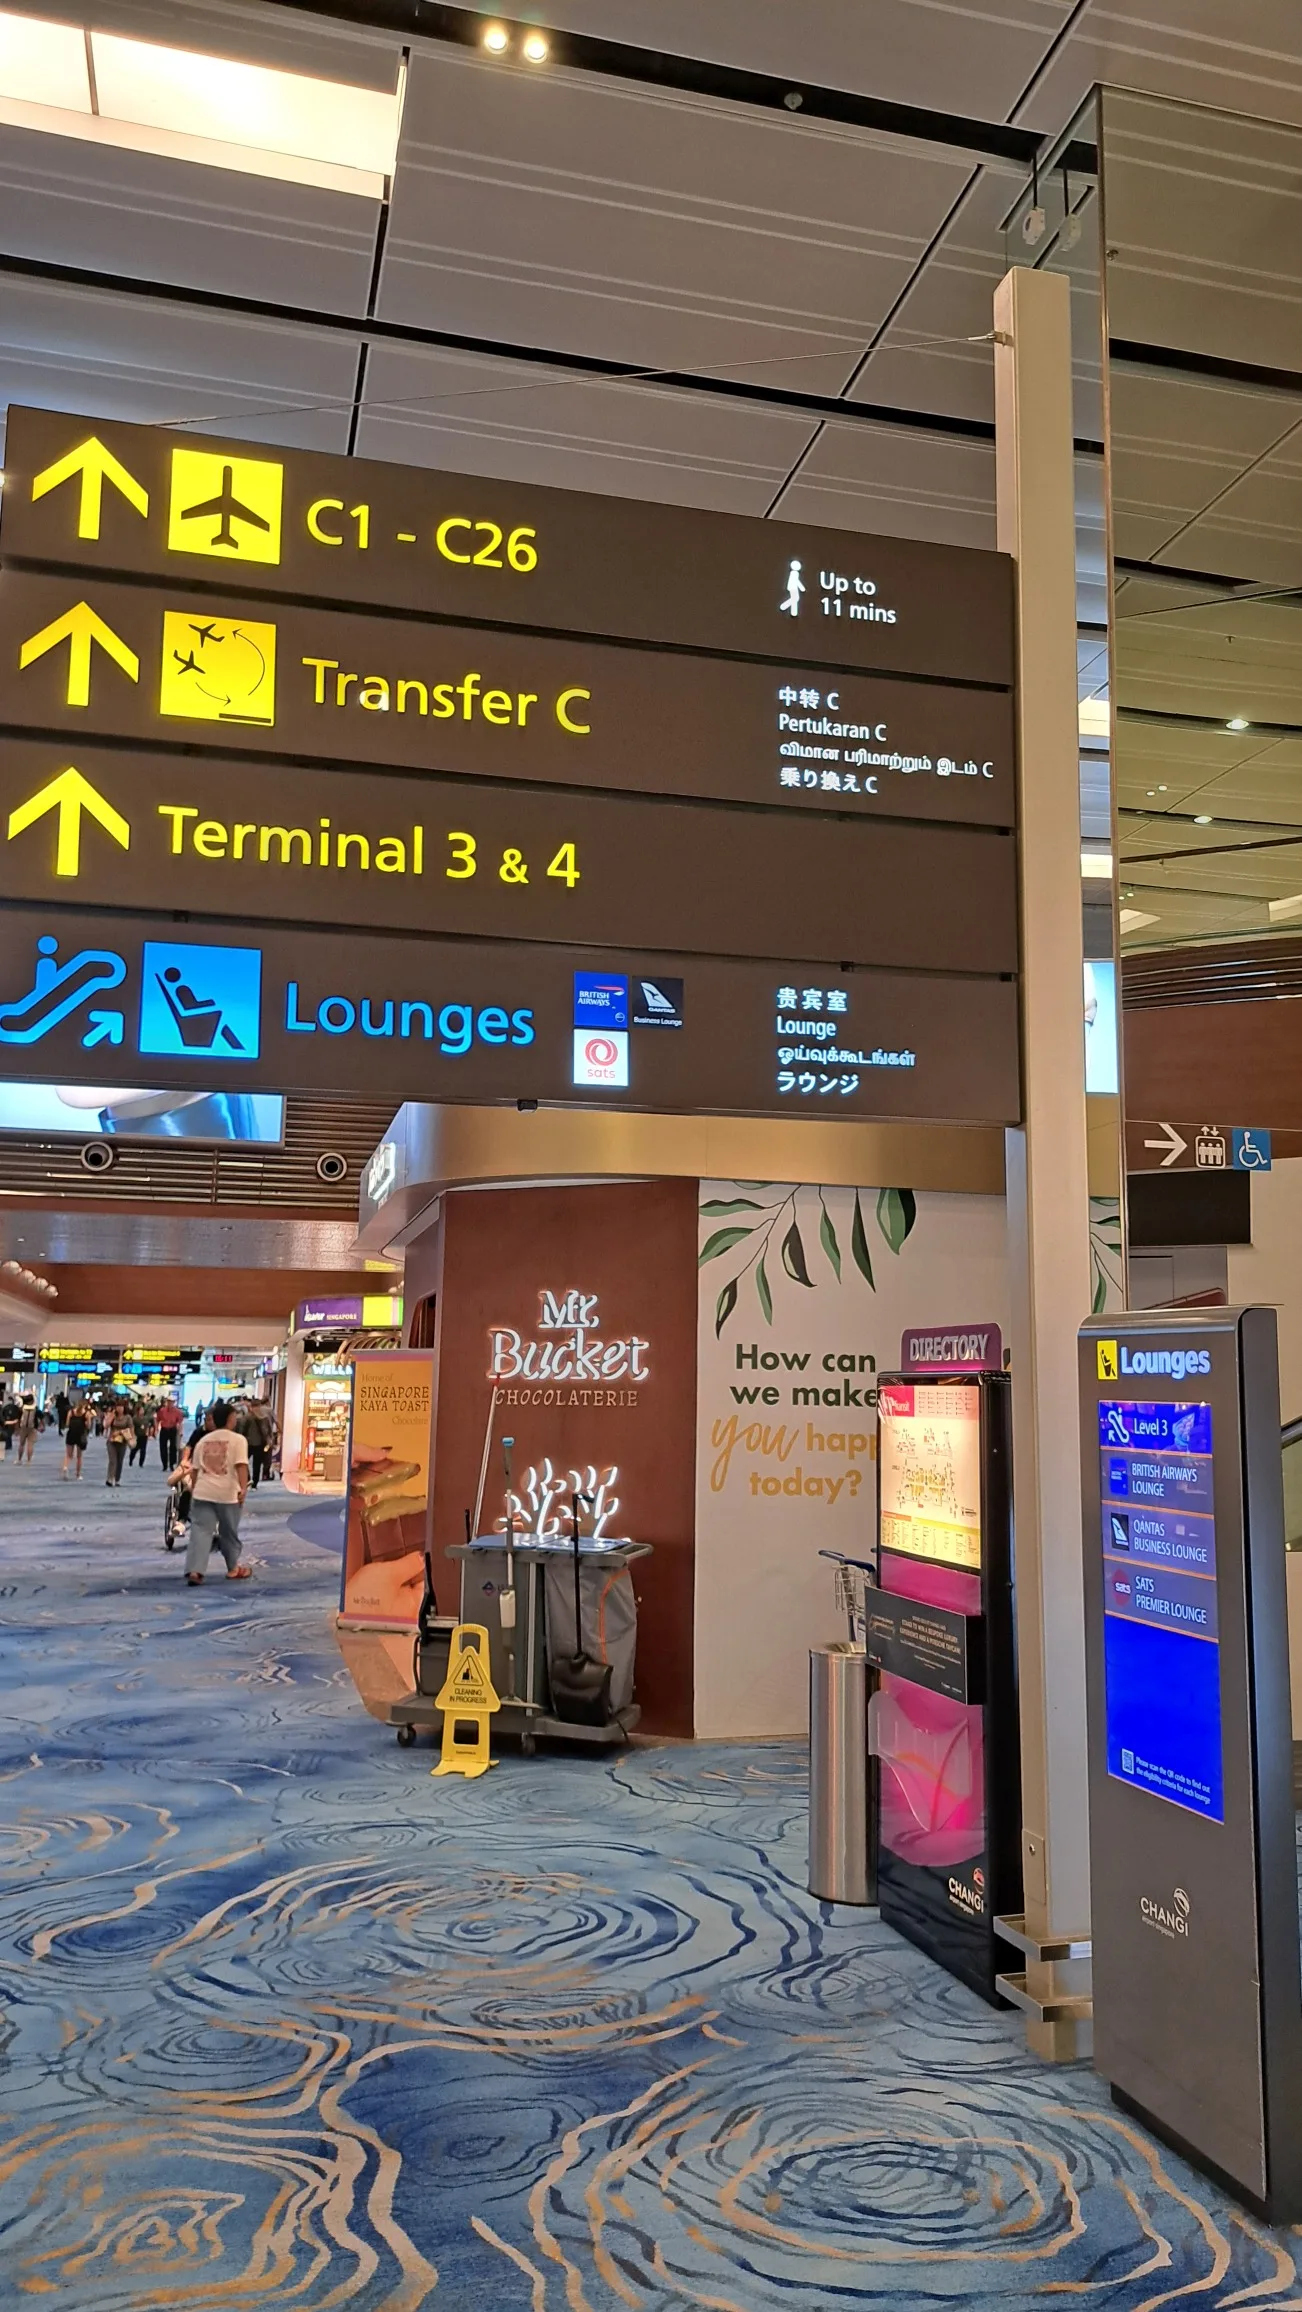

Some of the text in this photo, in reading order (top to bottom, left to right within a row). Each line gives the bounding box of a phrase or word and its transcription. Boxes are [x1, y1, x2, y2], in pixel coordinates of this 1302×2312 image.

[307, 499, 539, 573] C1 - C26
[819, 571, 876, 596] Up to
[821, 597, 897, 624] 11 mins
[302, 657, 592, 734] Transfer C
[778, 686, 840, 711] 中转 C
[778, 713, 887, 742] Pertukaran C
[780, 767, 878, 794] 乗り換え C
[982, 761, 994, 778] C
[158, 805, 581, 889] Terminal 3 & 4
[578, 997, 610, 1006] AIRWAYS
[579, 990, 609, 999] BRITISH
[777, 986, 848, 1012] 贵宾室
[285, 982, 535, 1054] Lounges
[633, 1016, 682, 1027] Business Lounge
[777, 1015, 837, 1040] Lounge
[587, 1068, 616, 1079] sats
[777, 1071, 859, 1094] ラウンジ
[486, 1328, 650, 1381] Bucket
[736, 1344, 876, 1373] How can
[910, 1334, 989, 1362] DIRECTORY
[1120, 1346, 1211, 1380] Lounges
[360, 1386, 429, 1398] SINGAPORE
[495, 1389, 638, 1407] CHOCOLATERIE
[729, 1386, 780, 1406] we
[792, 1379, 878, 1407] make
[360, 1400, 429, 1411] KAYA TOAST
[1134, 1418, 1168, 1436] Level 3
[711, 1415, 800, 1492] you
[1132, 1463, 1160, 1479] BRITISH
[1162, 1466, 1198, 1482] AIRWAYS
[750, 1467, 863, 1504] today?
[1132, 1481, 1164, 1497] LOUNGE
[1134, 1519, 1165, 1536] QANTAS
[1134, 1537, 1207, 1563] BUSINESS LOUNGE
[1115, 1582, 1131, 1594] sats
[1135, 1576, 1154, 1592] SATS
[1136, 1594, 1207, 1624] PREMIER LOUNGE
[449, 1695, 487, 1704] IN PROGRESS
[454, 1688, 482, 1696] CLEANING
[1149, 1763, 1159, 1772] scan
[1159, 1765, 1167, 1775] the
[1167, 1769, 1174, 1779] QR
[1186, 1777, 1191, 1786] to
[948, 1877, 984, 1914] CHANGI
[1140, 1897, 1188, 1937] CHANGI
